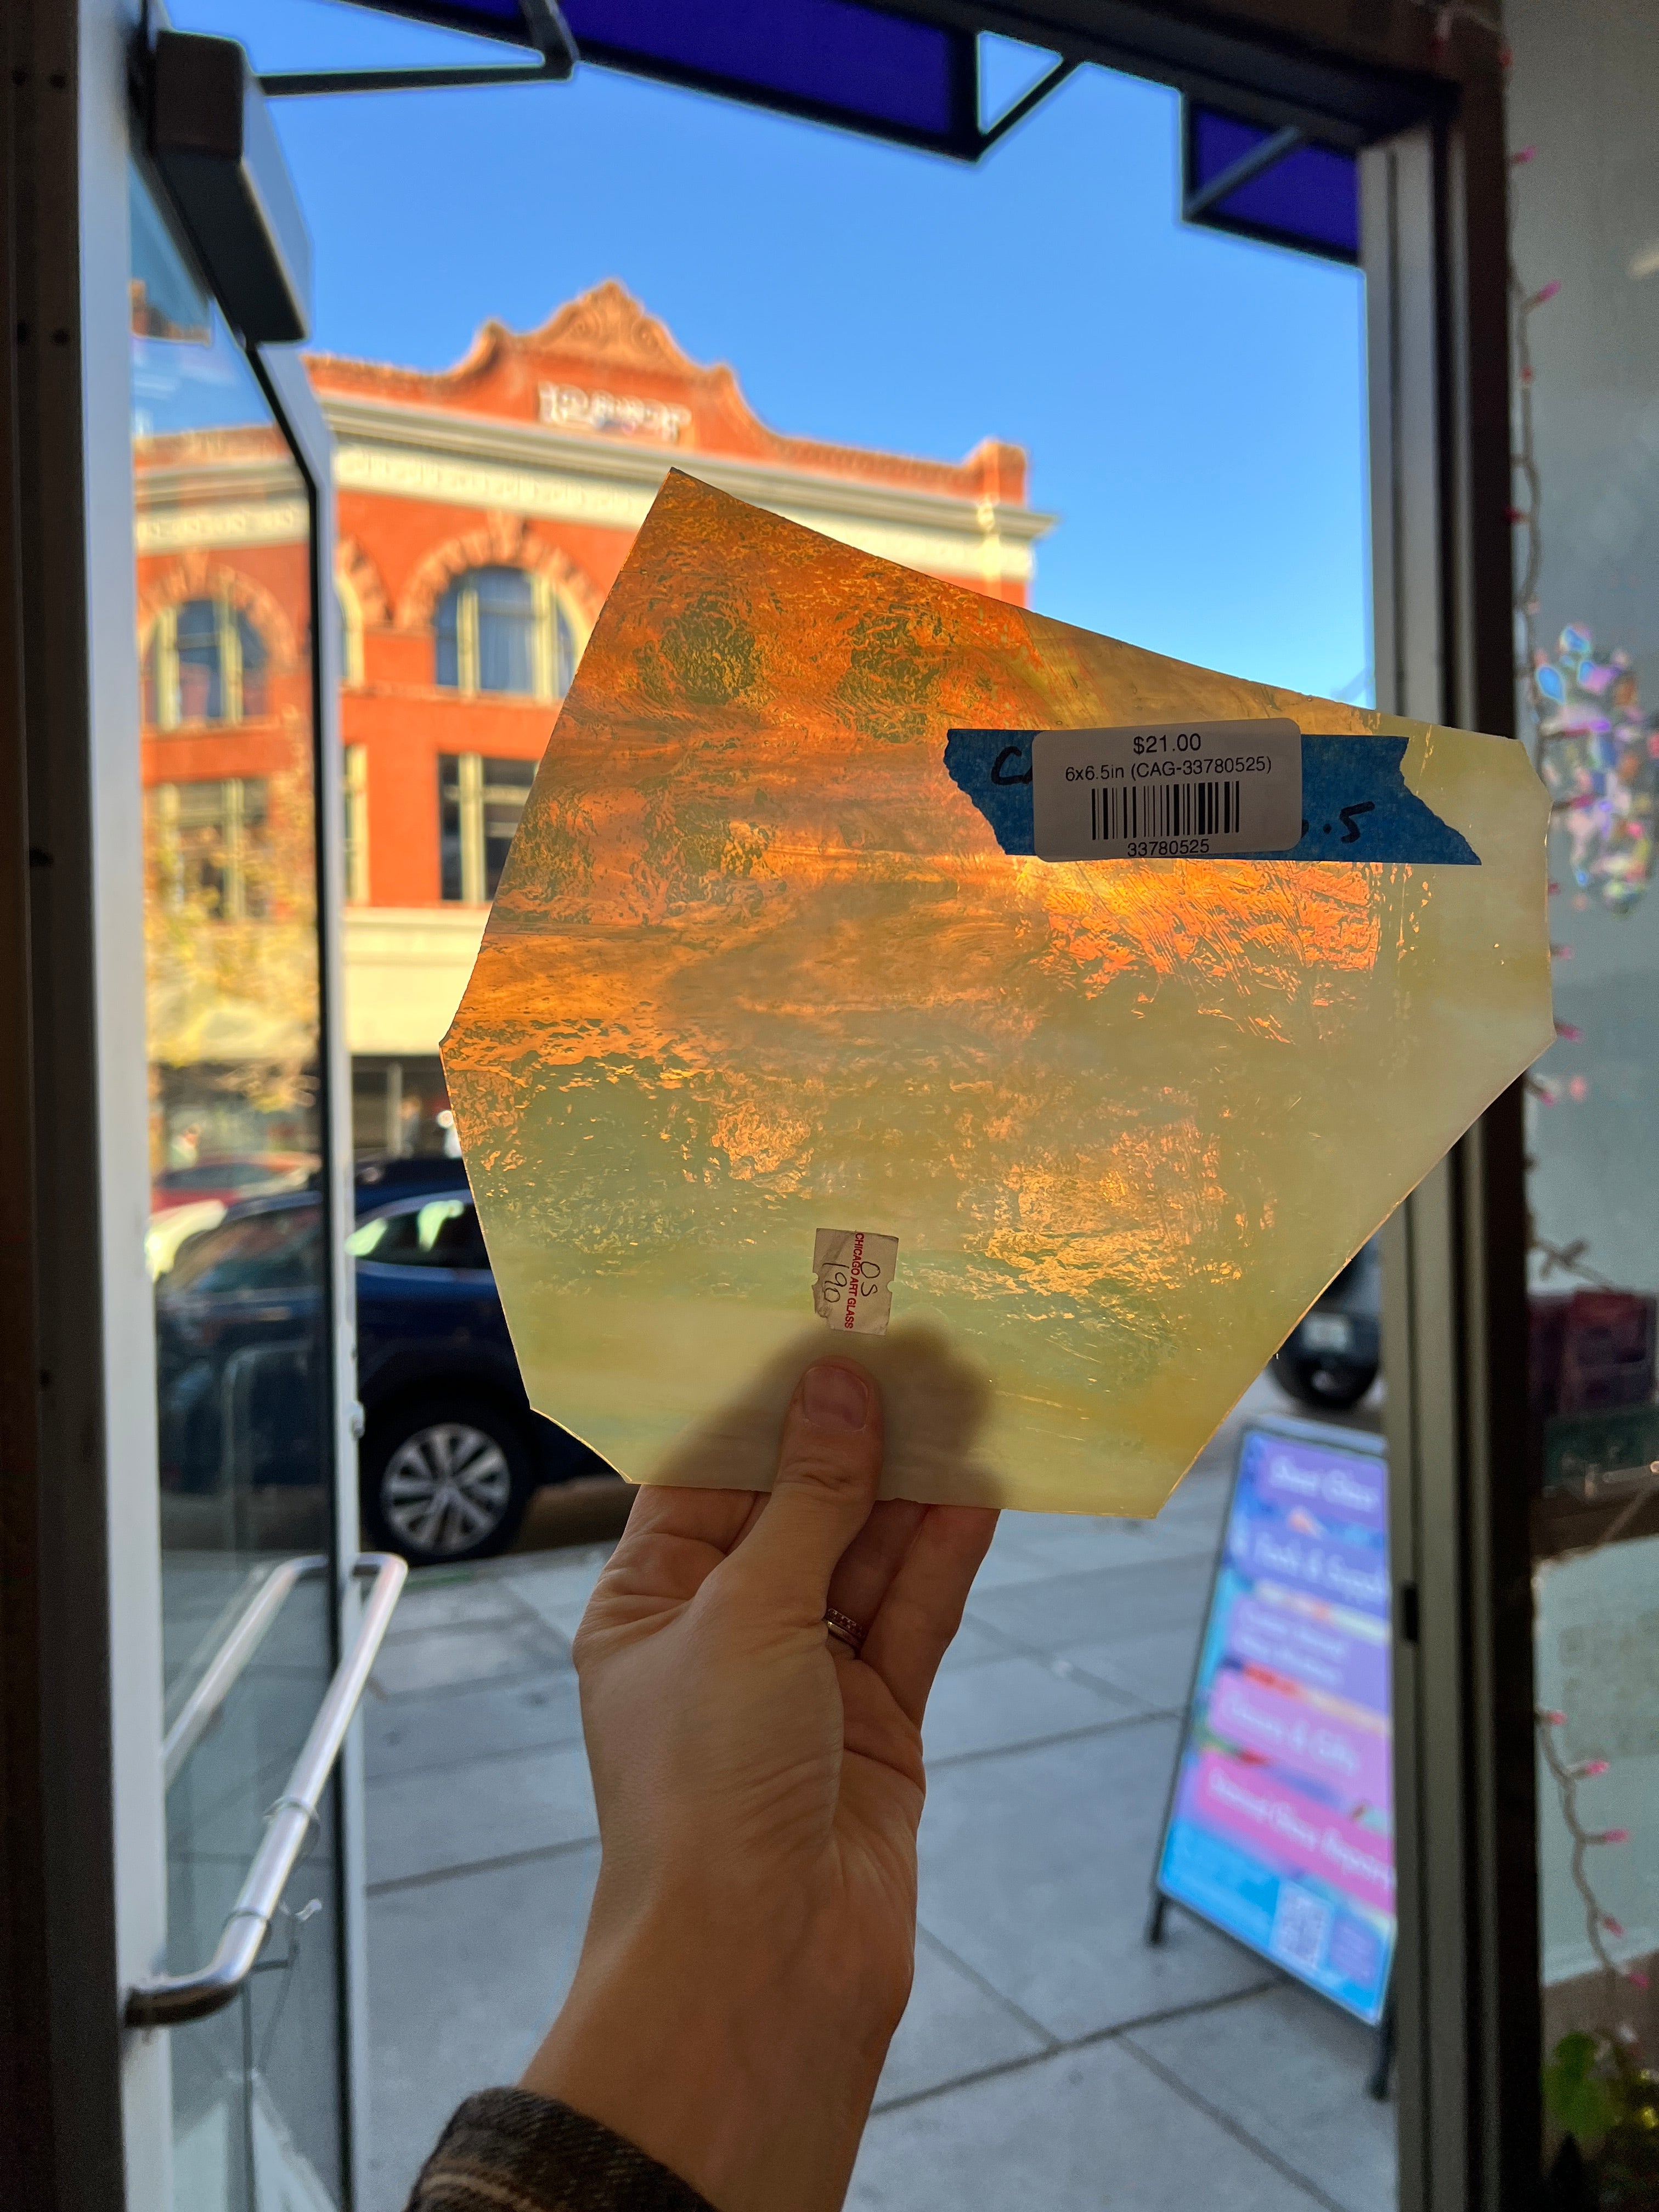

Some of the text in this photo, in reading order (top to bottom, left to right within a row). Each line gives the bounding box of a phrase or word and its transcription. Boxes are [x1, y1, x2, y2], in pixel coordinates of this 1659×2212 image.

[1133, 733, 1201, 755] $21.00
[991, 746, 1033, 786] C
[1065, 756, 1272, 782] 6x6.5in (CAG-33780525)
[1301, 800, 1375, 844] .5
[1127, 838, 1210, 857] 33780525
[822, 1262, 850, 1303] 190
[844, 1233, 865, 1329] CHICAGO ART GLASS
